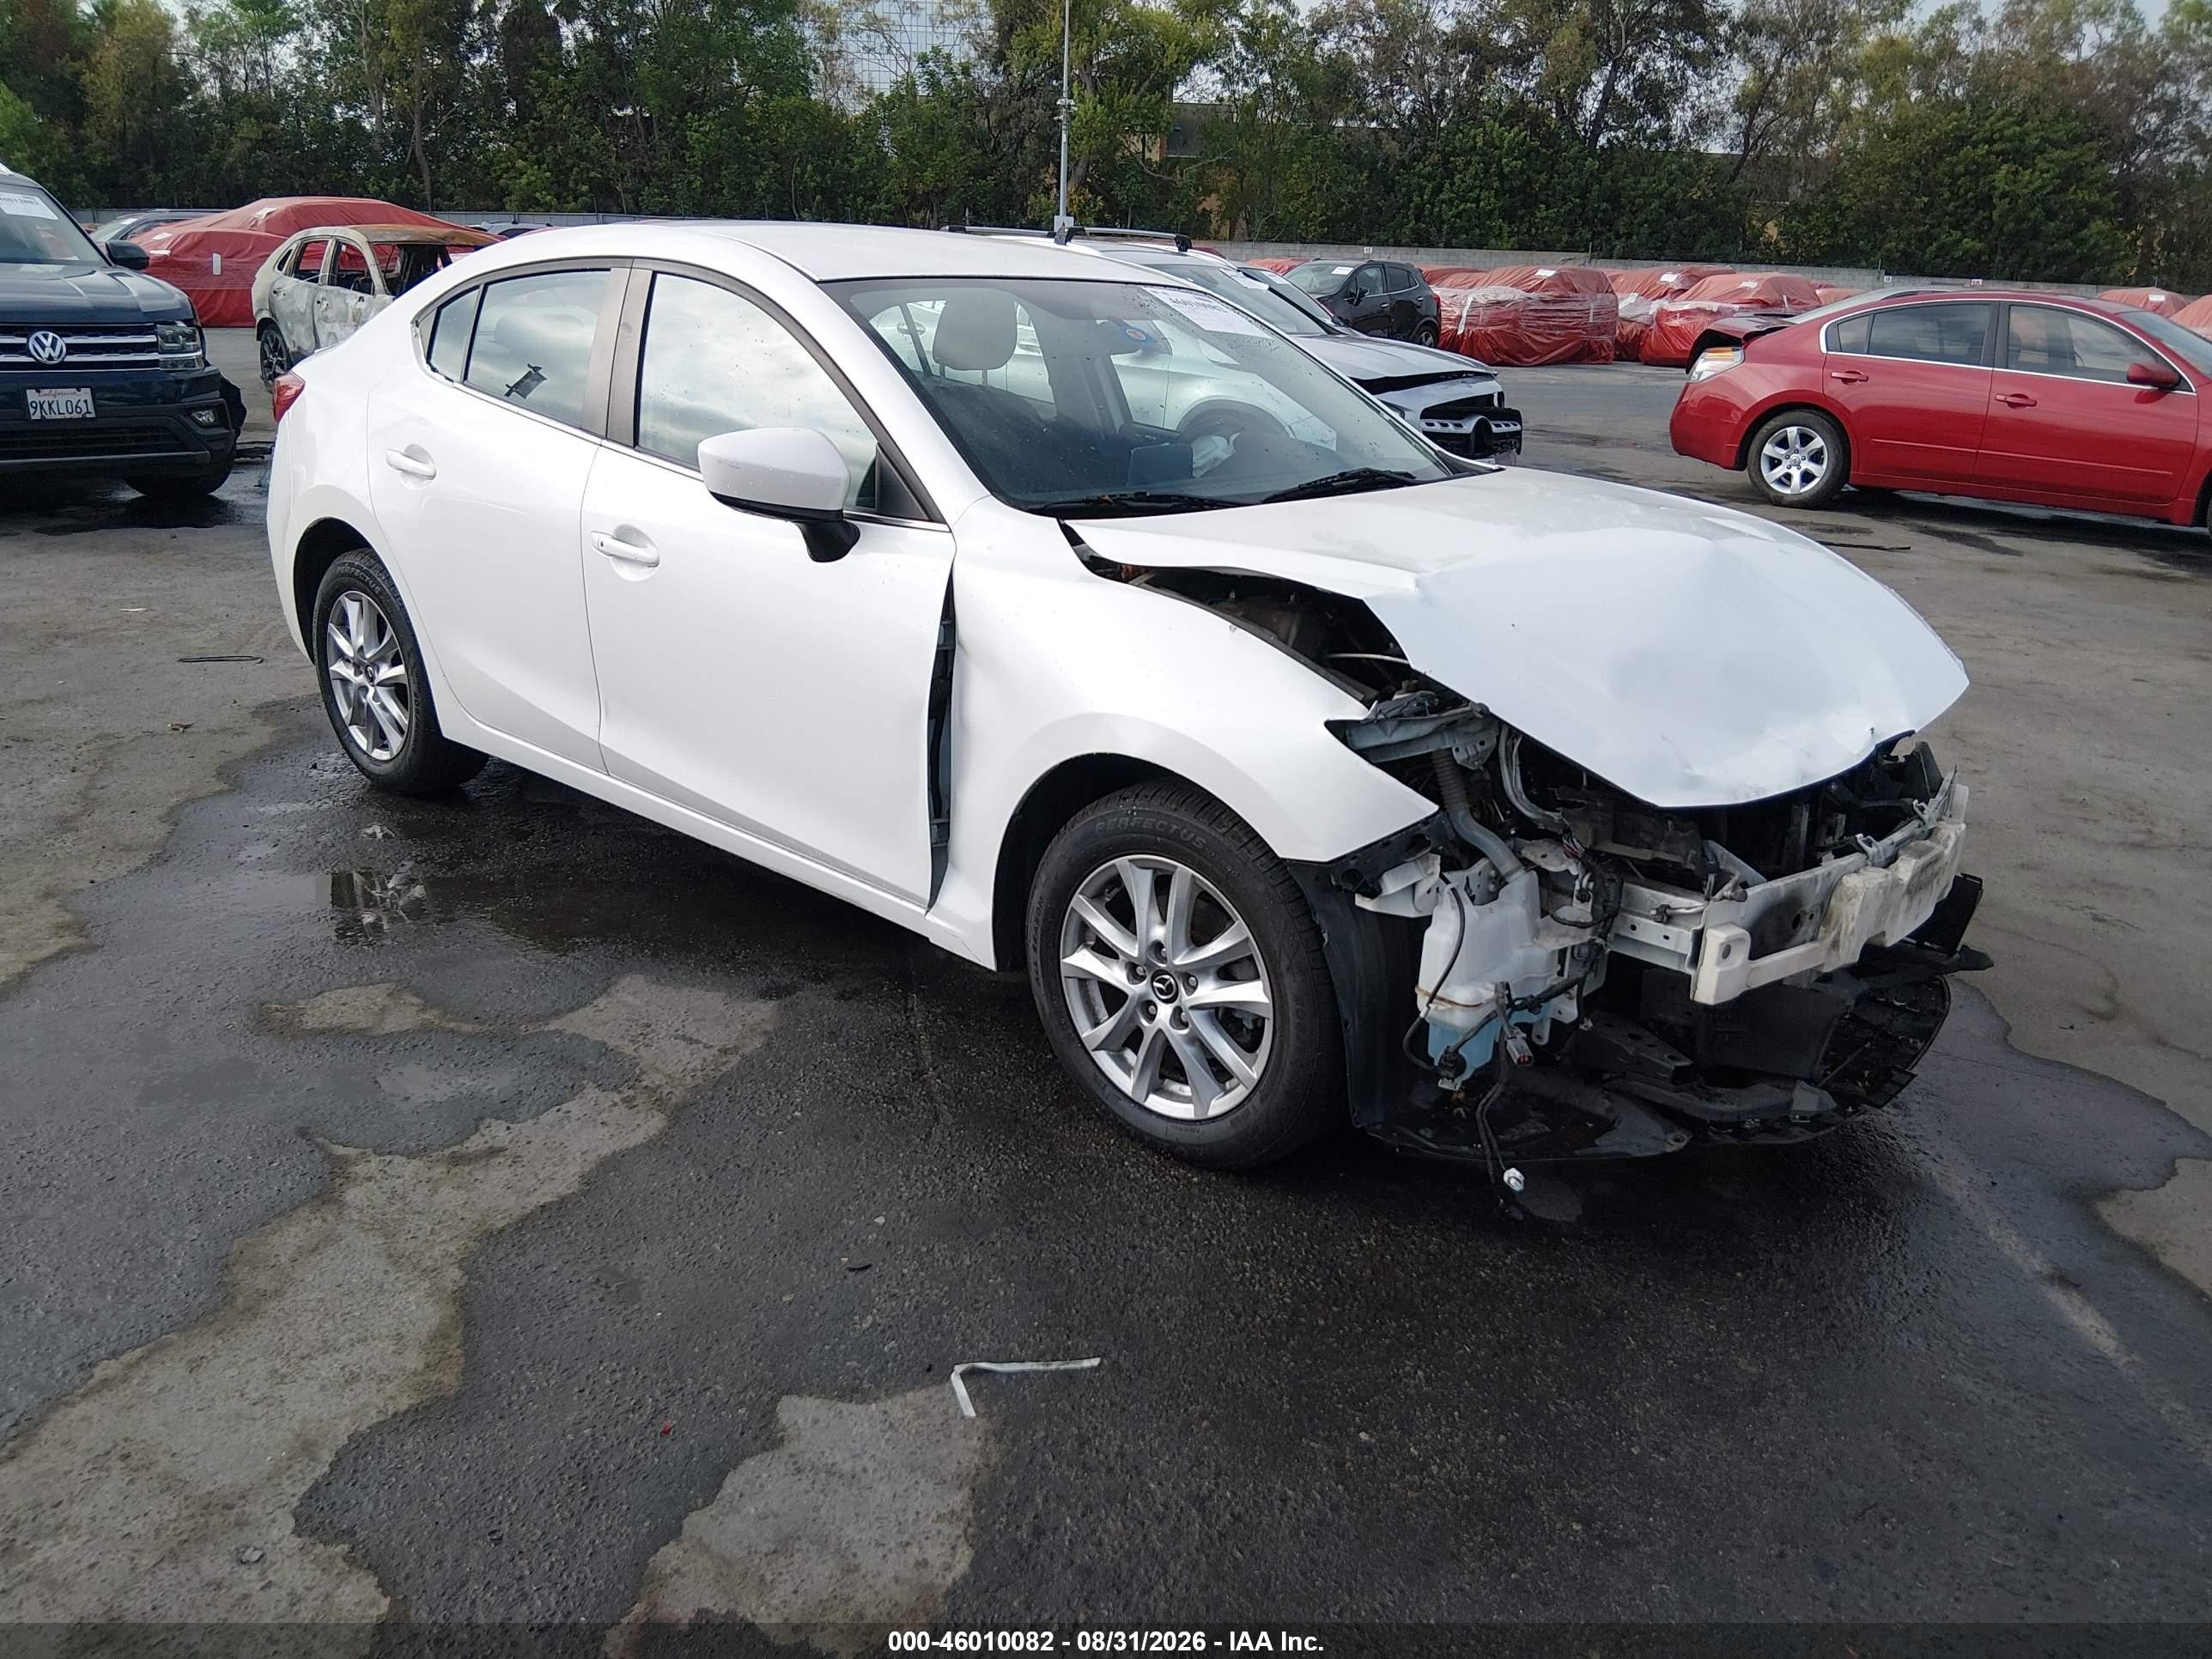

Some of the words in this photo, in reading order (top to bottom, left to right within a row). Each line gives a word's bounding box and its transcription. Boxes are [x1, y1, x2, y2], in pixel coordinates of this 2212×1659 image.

[29, 331, 66, 364] VW
[29, 398, 93, 416] 9KKL061
[336, 566, 381, 594] PERFECTUS
[1095, 817, 1207, 848] PERFECTUS
